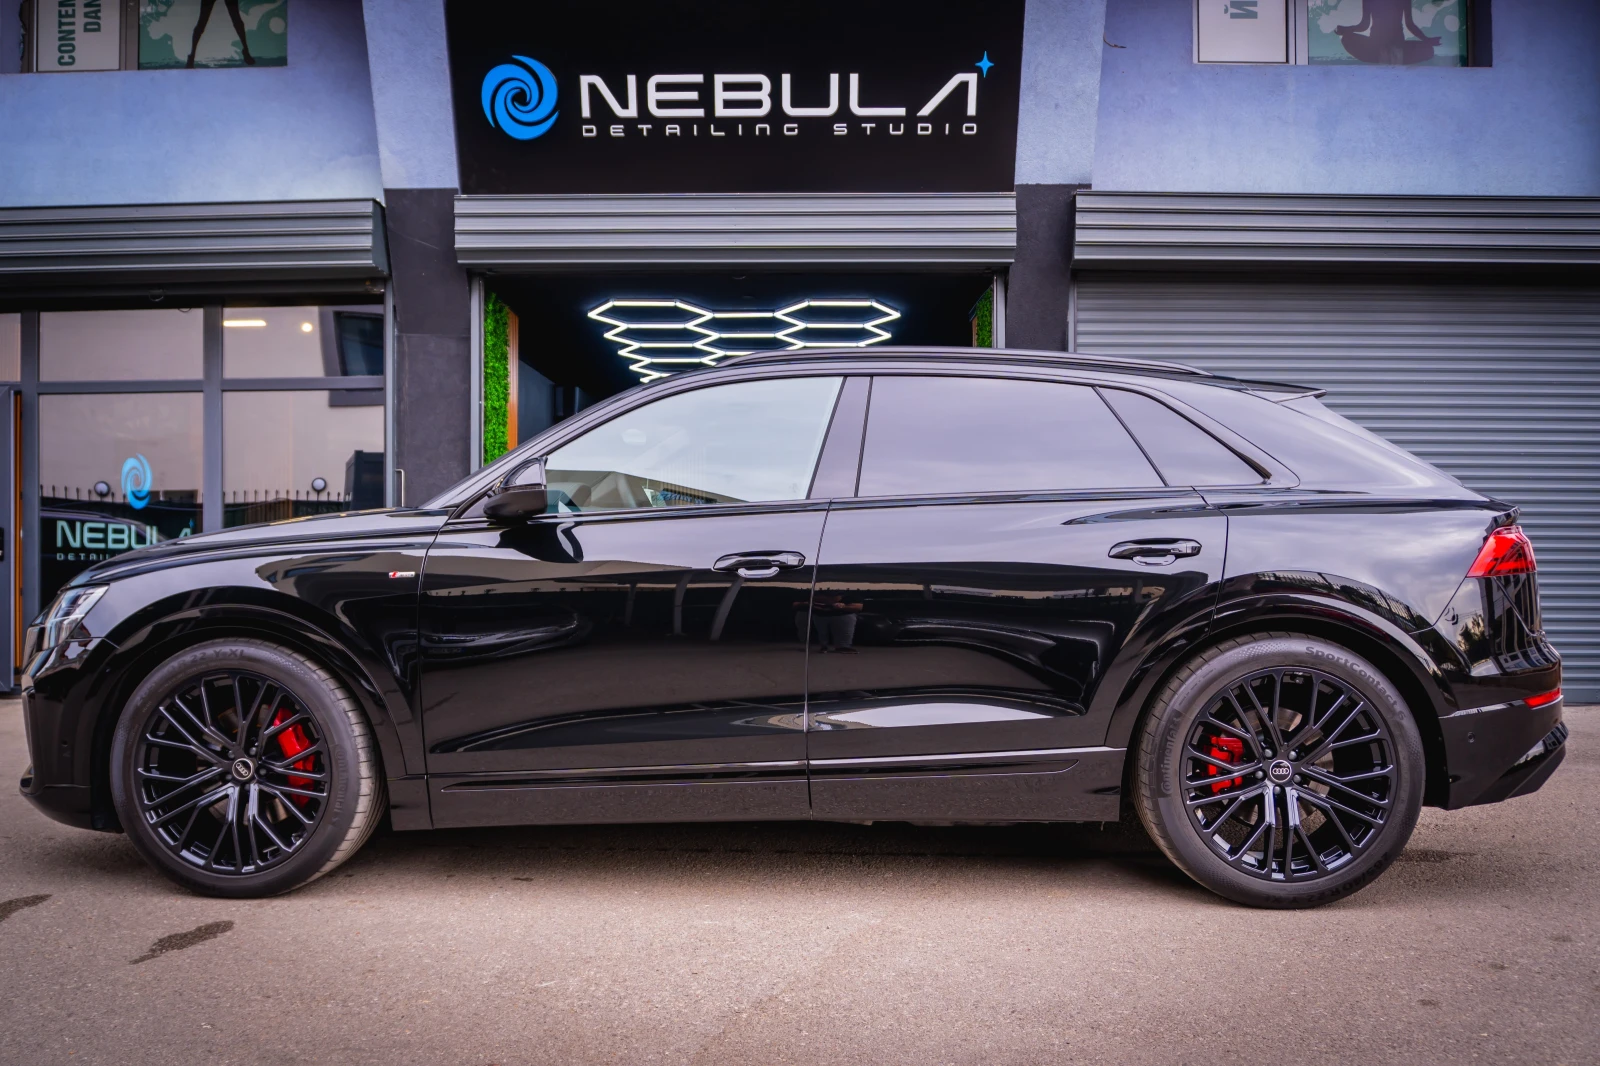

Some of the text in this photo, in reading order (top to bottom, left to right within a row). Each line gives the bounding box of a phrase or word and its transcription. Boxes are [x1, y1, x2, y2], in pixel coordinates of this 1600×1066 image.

[579, 73, 978, 119] NEBULA
[582, 122, 978, 137] DETAILING STUDIO
[1305, 646, 1398, 707] SportContact
